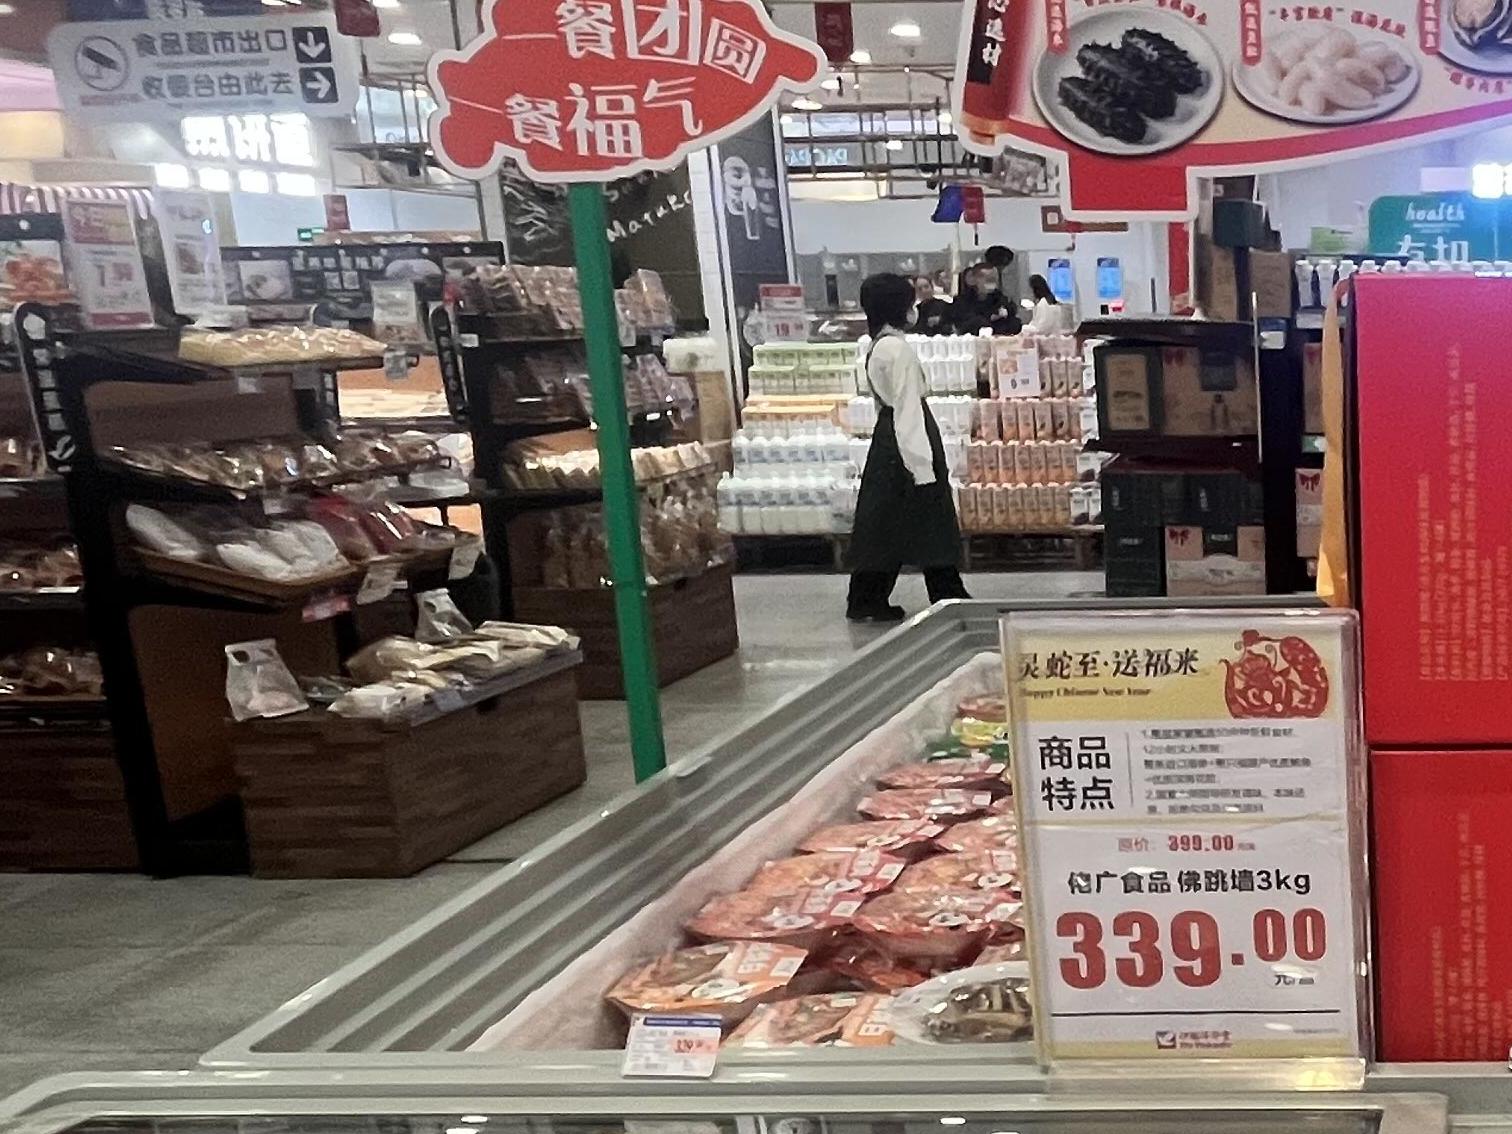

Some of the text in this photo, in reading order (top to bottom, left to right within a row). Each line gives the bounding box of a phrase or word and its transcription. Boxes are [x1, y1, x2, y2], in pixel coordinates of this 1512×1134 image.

[133, 29, 287, 57] 食品超市出口
[447, 76, 703, 160] 一餐福气
[1039, 735, 1111, 771] 商品
[1041, 776, 1115, 812] 特点
[1177, 868, 1312, 895] 佛跳墙3kg
[1055, 907, 1327, 989] 339.00
